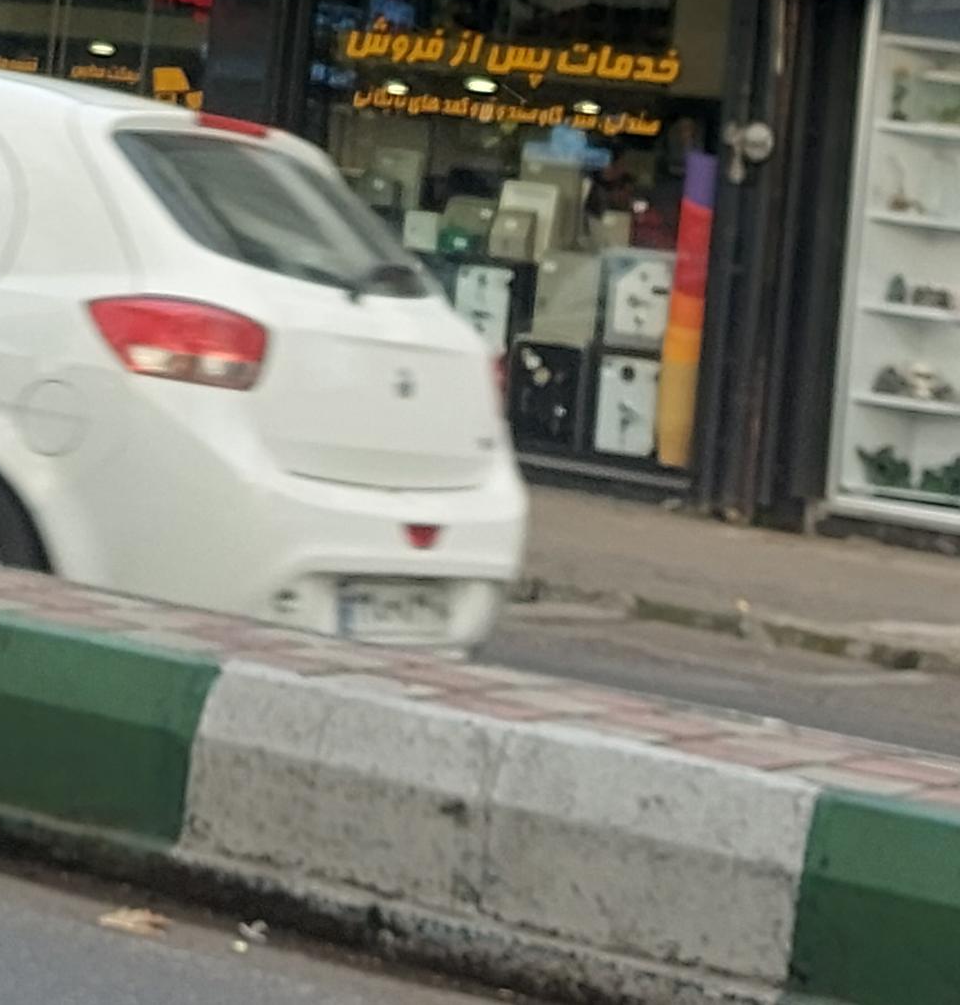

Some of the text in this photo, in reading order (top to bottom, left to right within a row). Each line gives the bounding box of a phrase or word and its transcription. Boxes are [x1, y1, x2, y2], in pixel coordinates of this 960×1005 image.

[346, 15, 681, 89] خدمات پس از فروش
